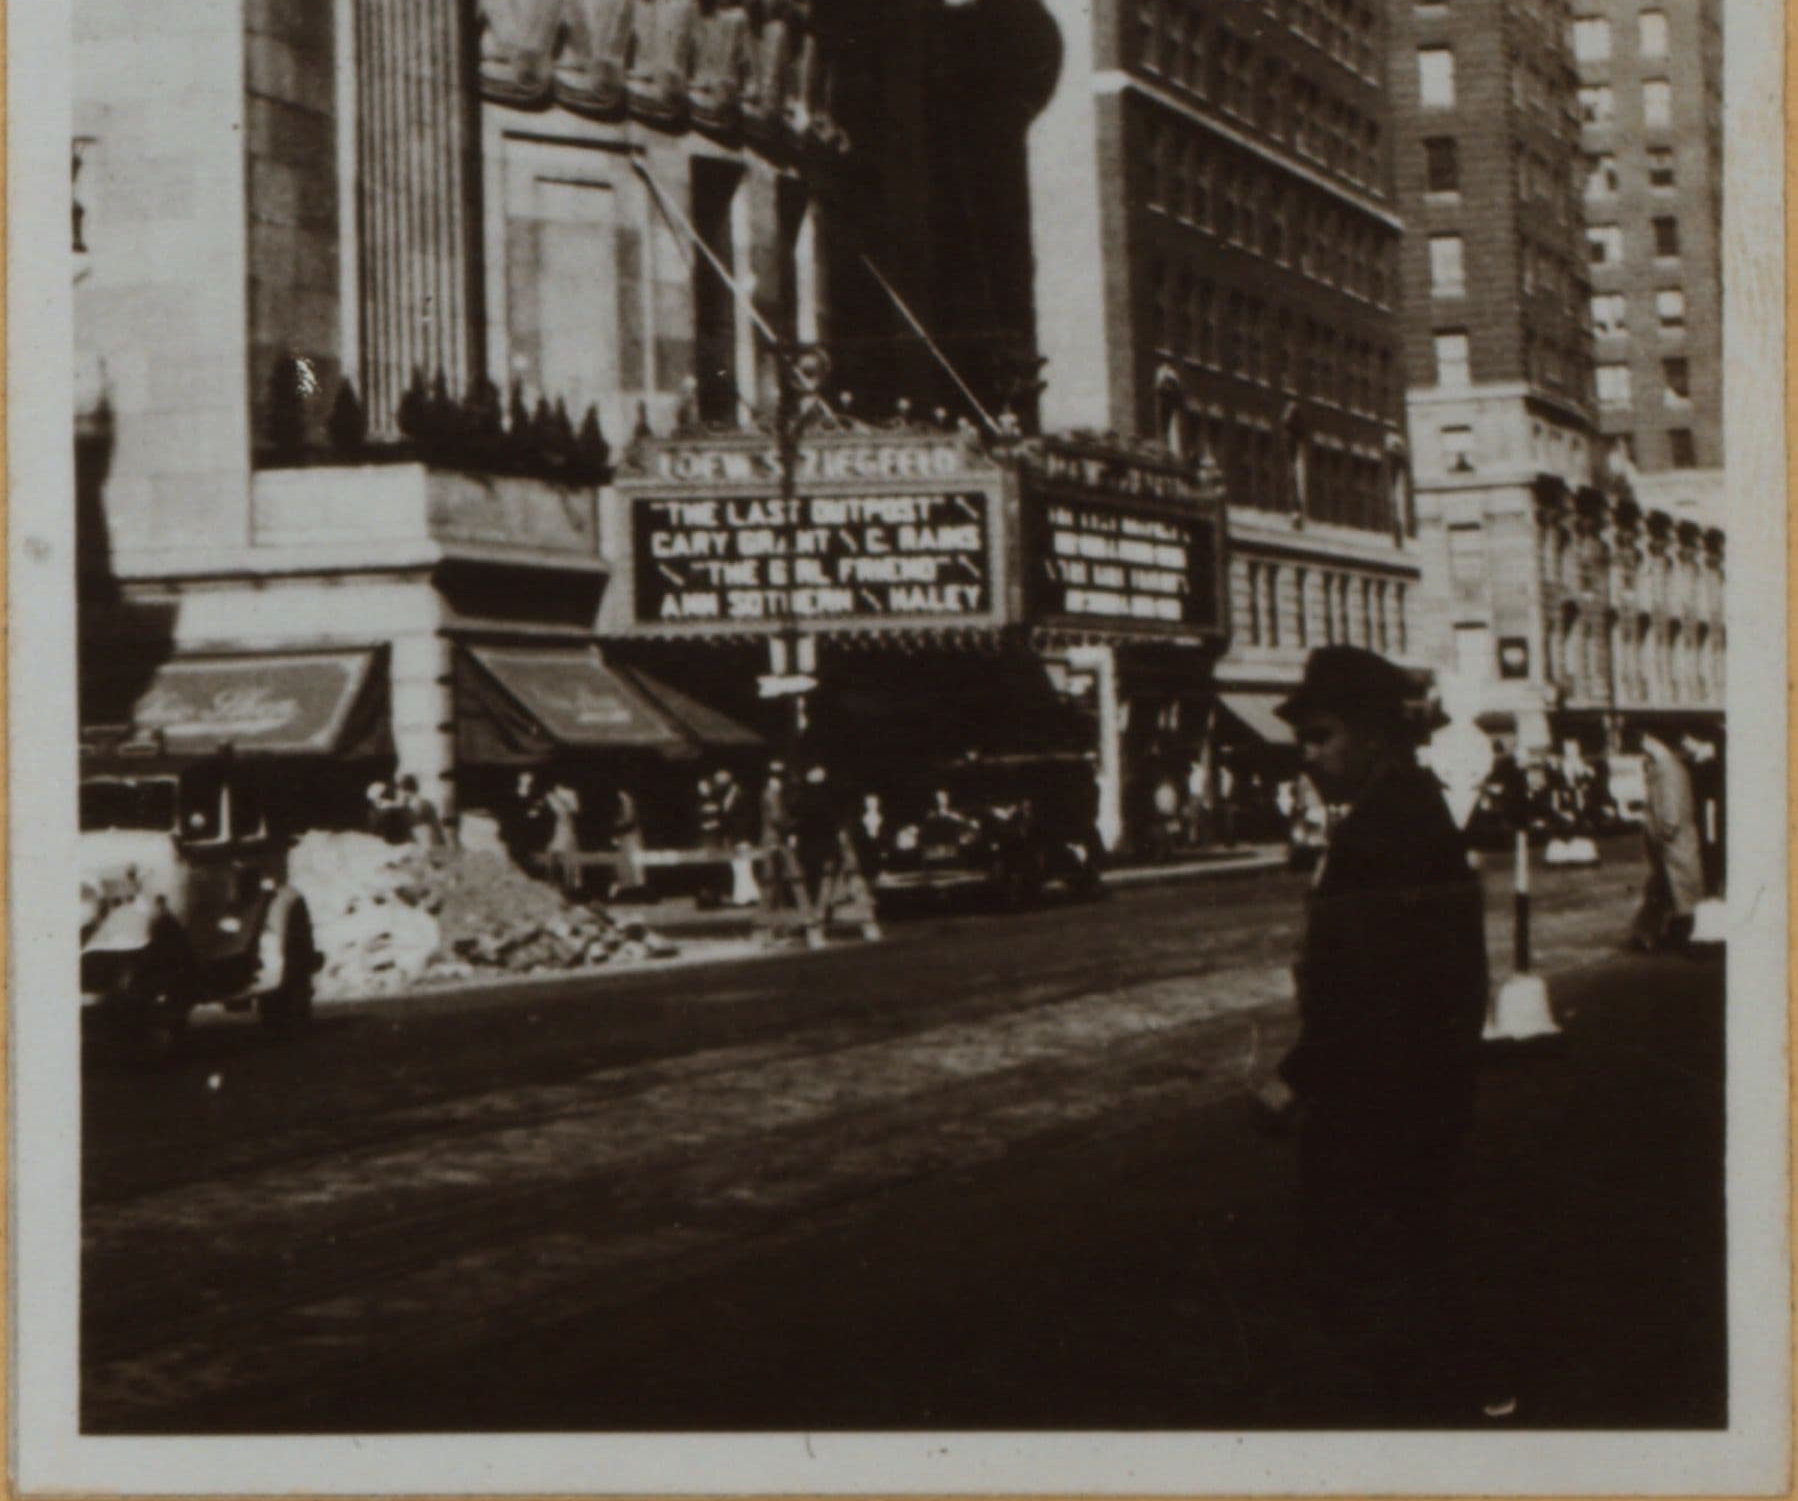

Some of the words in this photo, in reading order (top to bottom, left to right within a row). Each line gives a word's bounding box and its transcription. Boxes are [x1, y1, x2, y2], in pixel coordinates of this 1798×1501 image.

[797, 446, 957, 477] ZIEGFELD
[726, 499, 800, 526] LAST
[651, 531, 728, 557] CARY
[769, 558, 831, 585] GRL
[889, 584, 981, 612] HALEY
